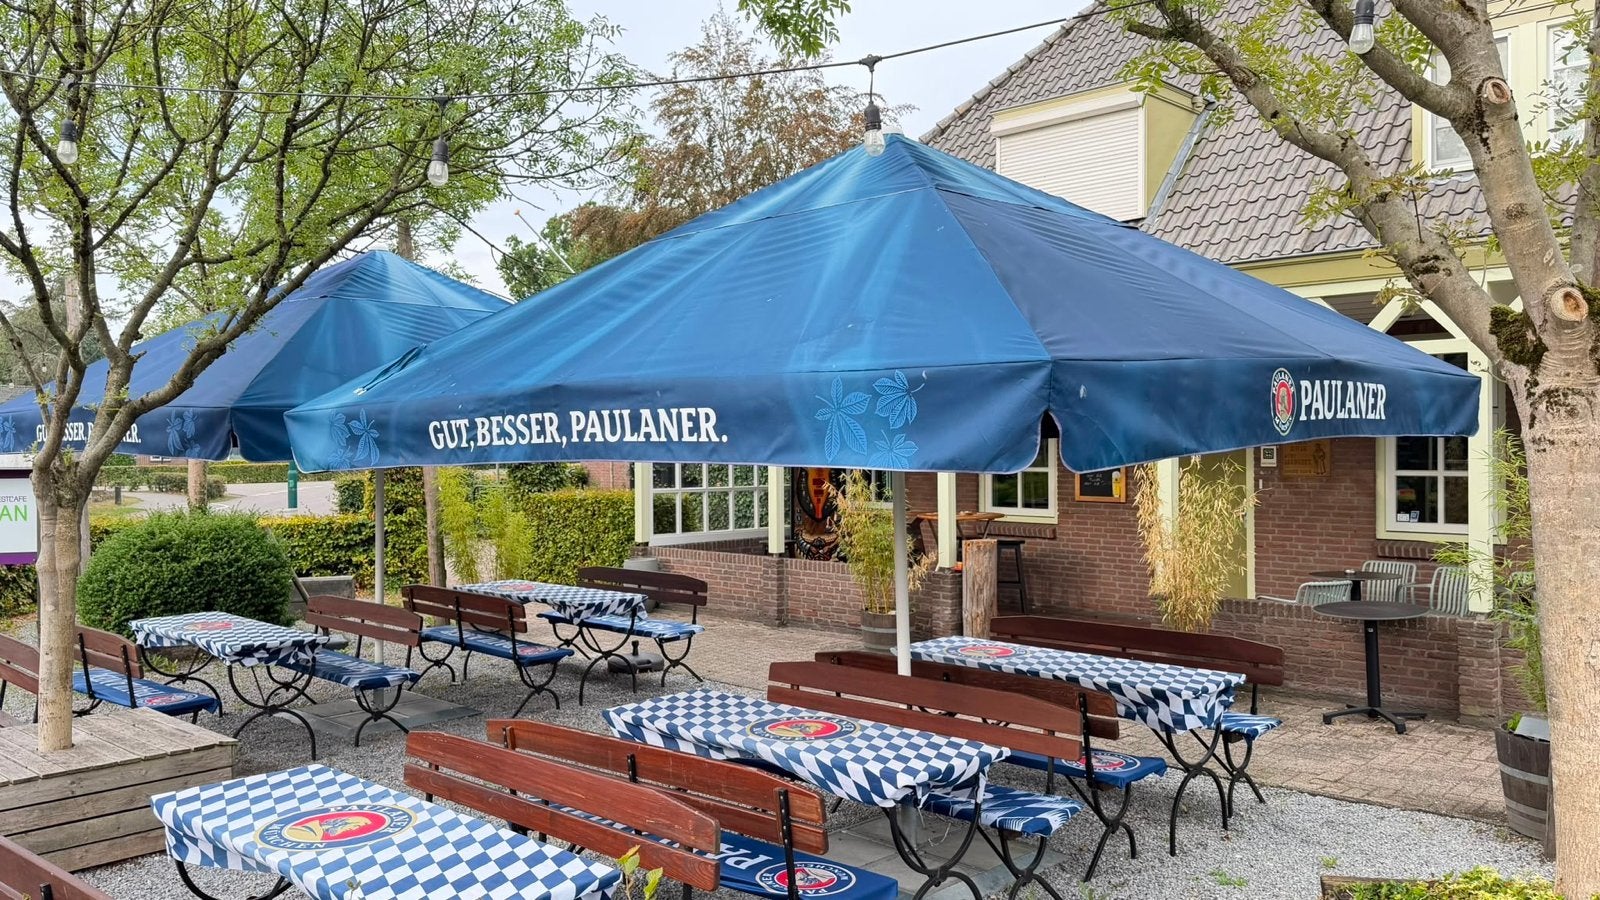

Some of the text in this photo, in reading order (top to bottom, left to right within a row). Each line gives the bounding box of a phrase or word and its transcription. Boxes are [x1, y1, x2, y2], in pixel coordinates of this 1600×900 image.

[1299, 379, 1387, 421] PAULANER
[428, 407, 729, 452] GUT, BESSER, PAULANER.
[0, 495, 27, 503] STCAFE
[329, 804, 410, 833] PAULANER
